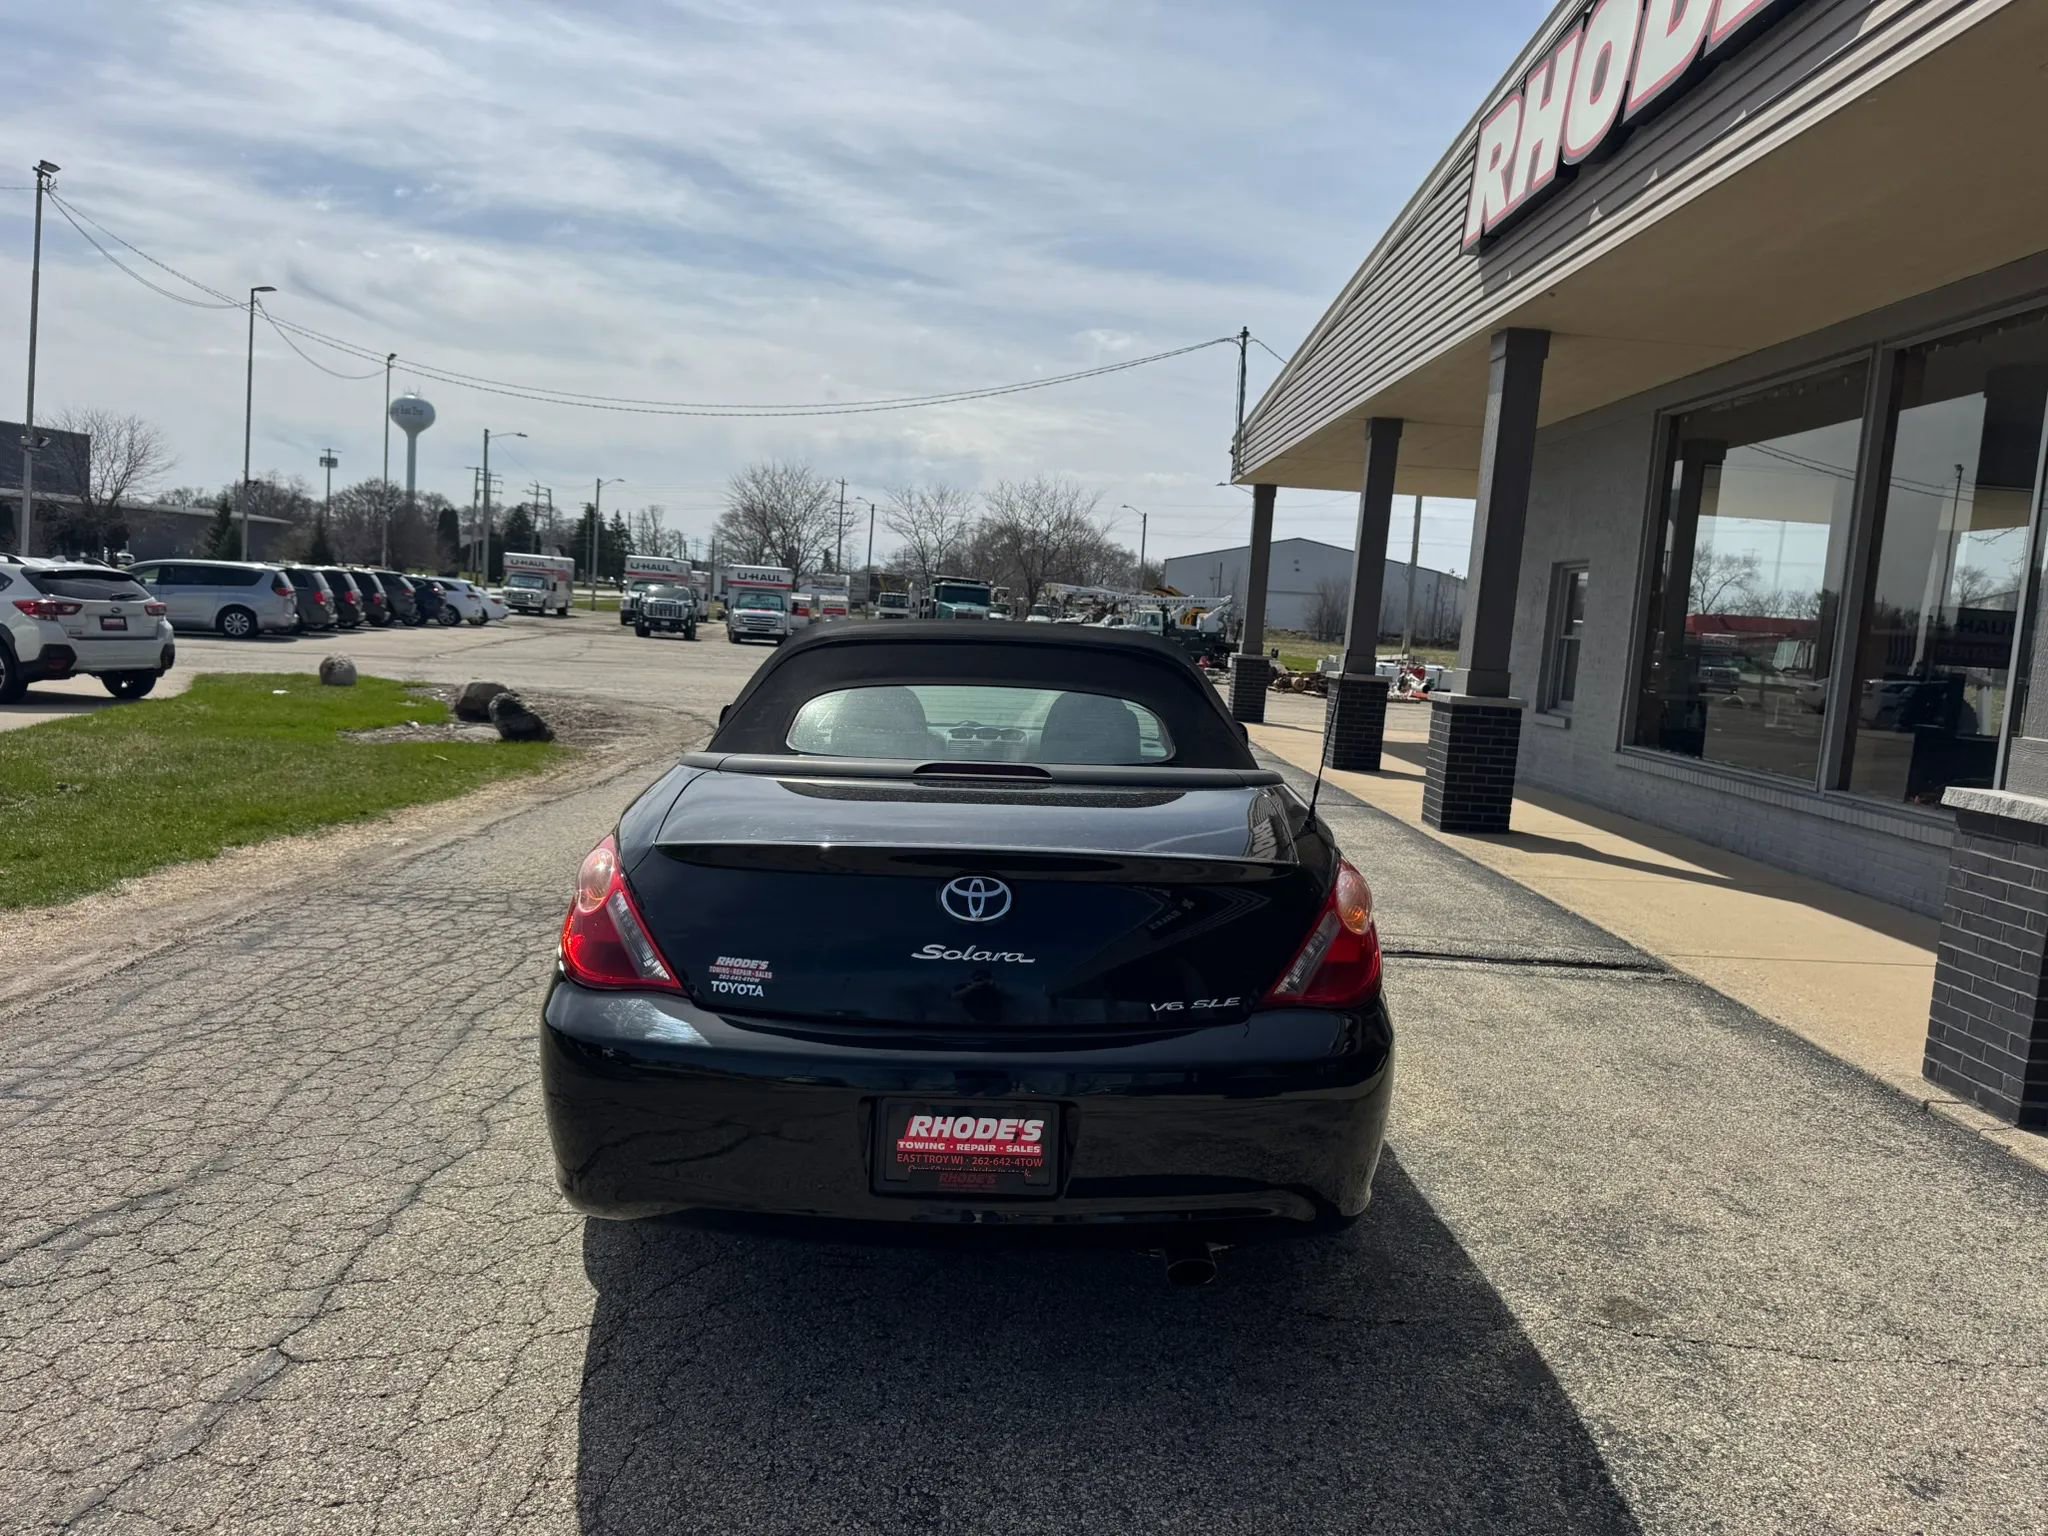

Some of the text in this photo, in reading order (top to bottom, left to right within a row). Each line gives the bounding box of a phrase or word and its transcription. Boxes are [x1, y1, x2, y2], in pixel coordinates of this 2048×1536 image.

[1462, 0, 1766, 250] RHOD
[630, 562, 672, 571] U-HAUL
[737, 572, 783, 582] U-HAUL
[911, 944, 1036, 963] Solara
[715, 956, 769, 970] RHODE'S
[711, 981, 764, 997] TOYOTA
[1150, 997, 1241, 1012] V6 SLE
[908, 1115, 1044, 1141] RHODE'S
[899, 1141, 1041, 1153] TOWING REPAIR SALES
[897, 1153, 1043, 1167] EAST TROY WI 262-642-4TOW
